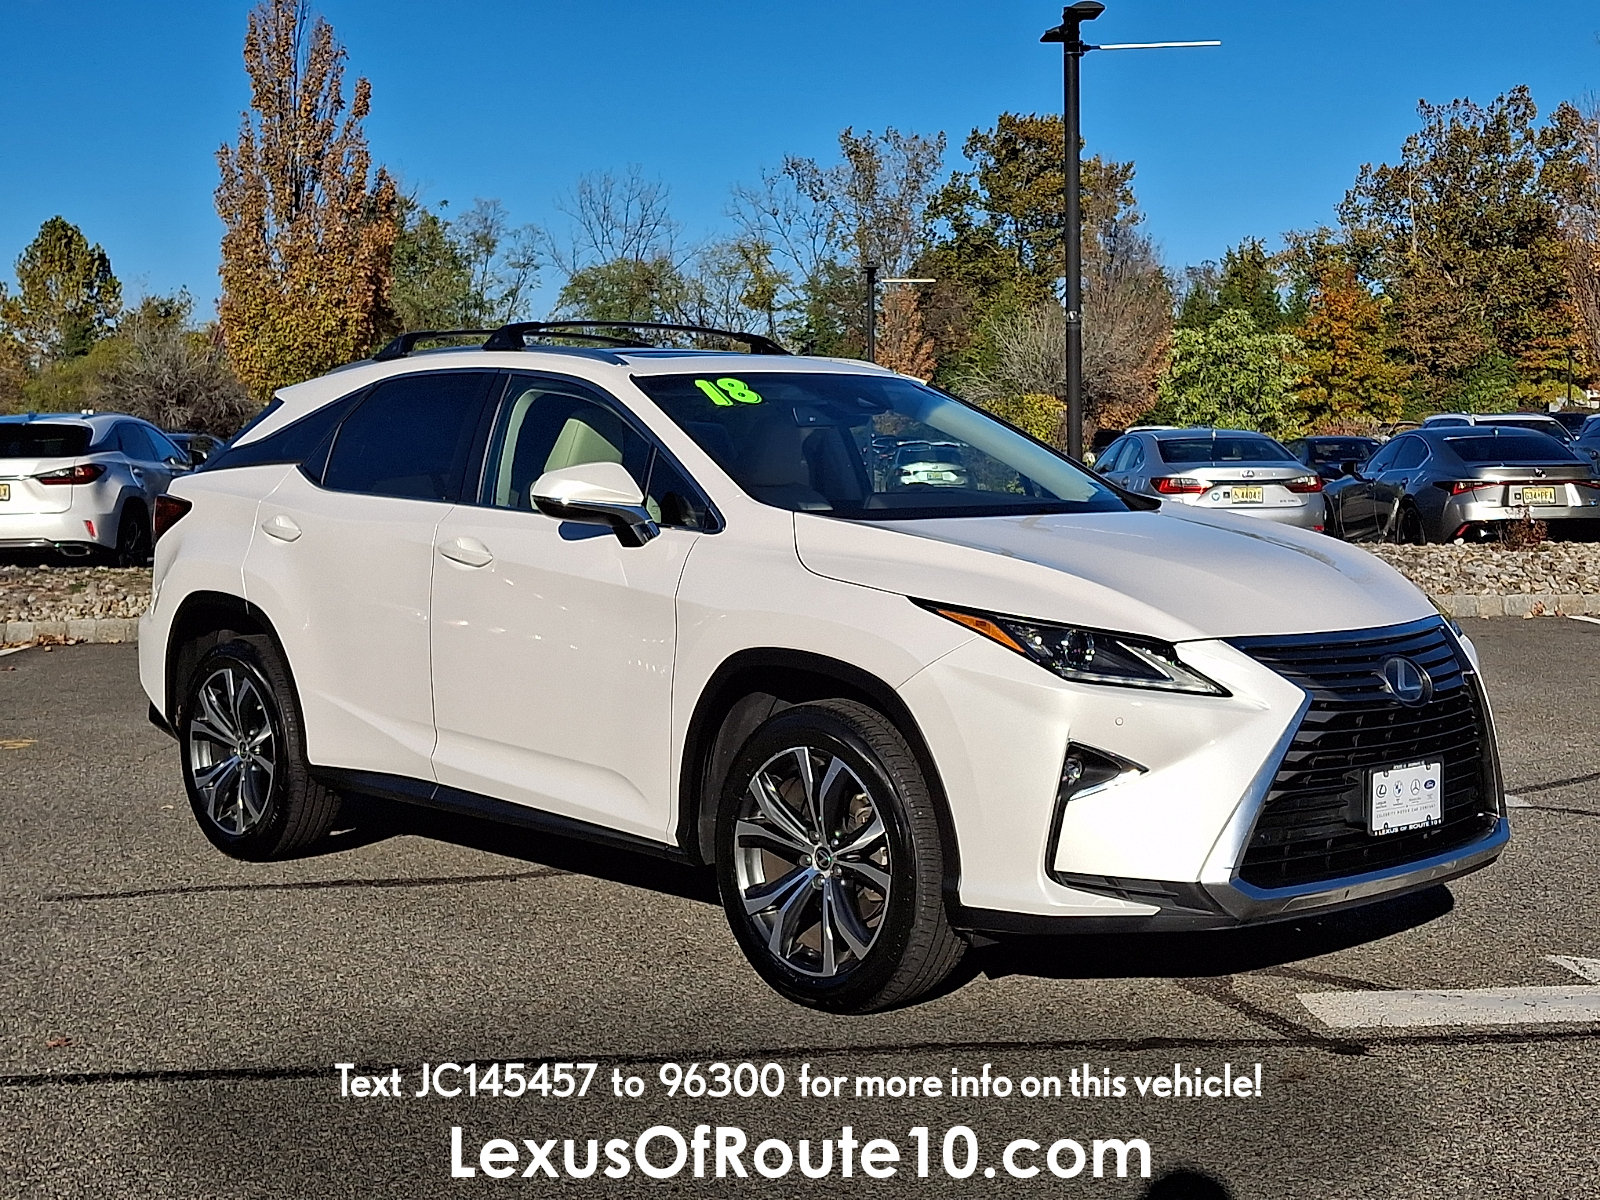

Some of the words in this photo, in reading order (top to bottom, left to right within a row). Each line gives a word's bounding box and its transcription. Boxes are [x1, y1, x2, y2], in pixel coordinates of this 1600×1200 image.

[694, 377, 763, 407] 18
[1379, 827, 1399, 836] LEXUS
[1409, 821, 1430, 830] ROUTE
